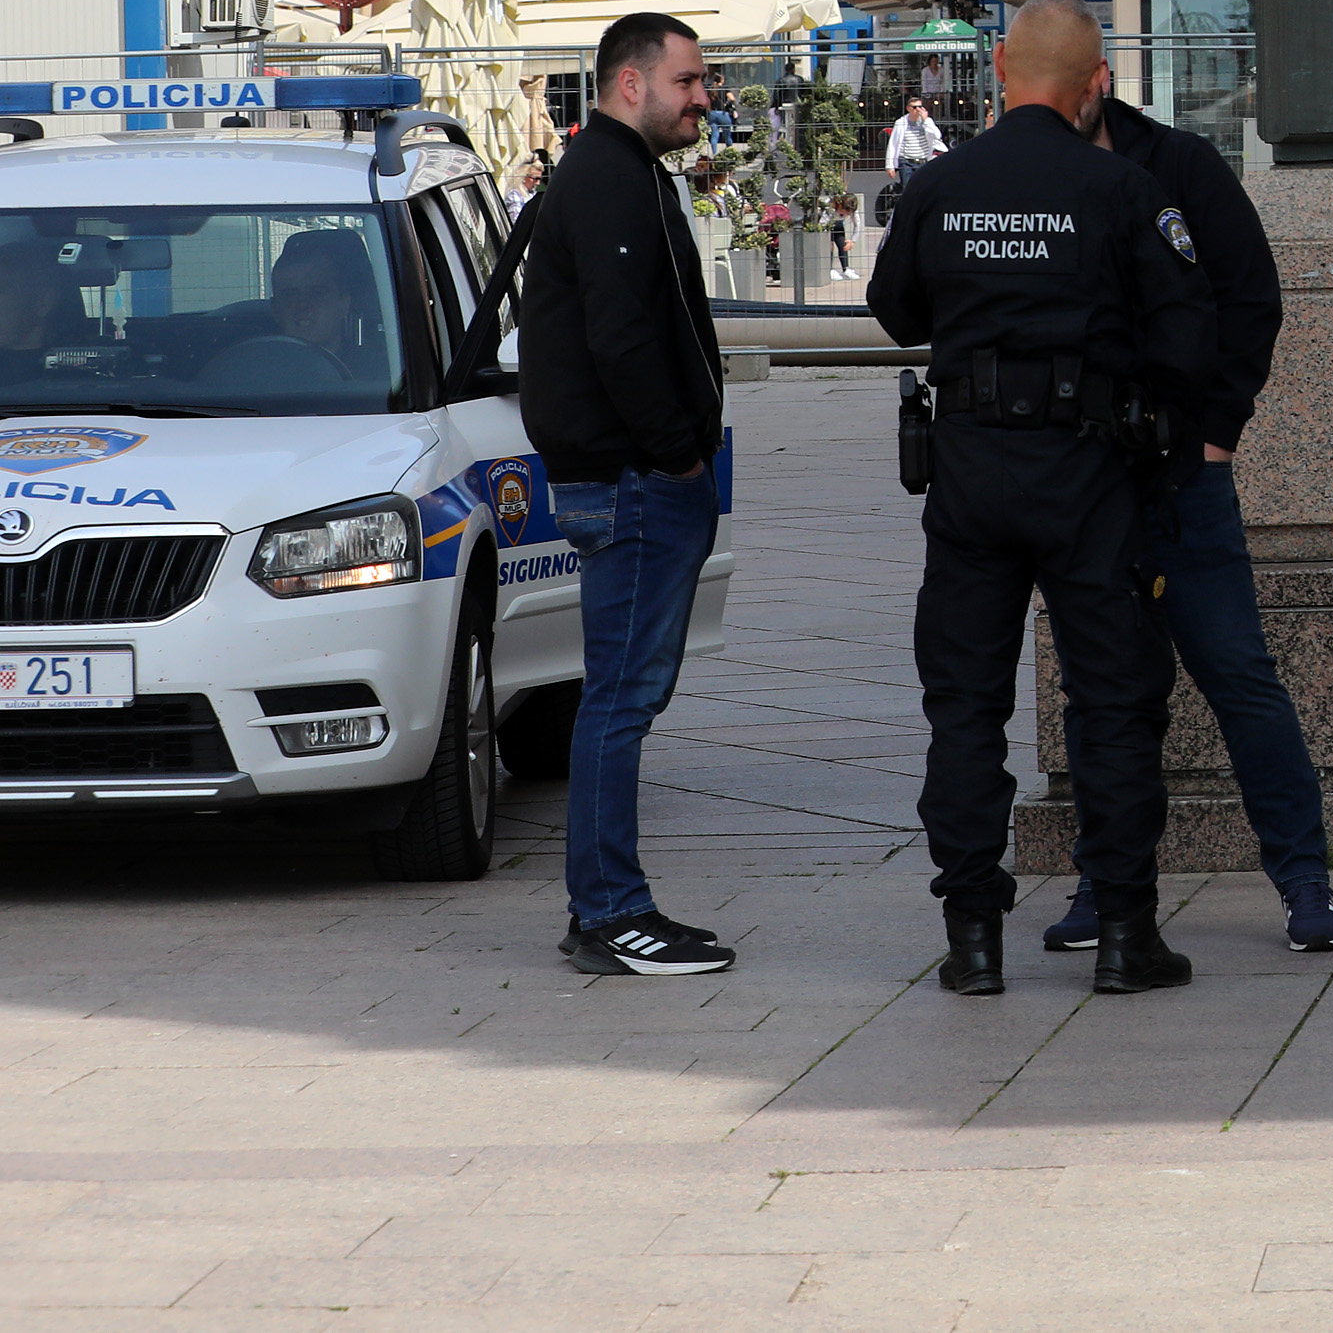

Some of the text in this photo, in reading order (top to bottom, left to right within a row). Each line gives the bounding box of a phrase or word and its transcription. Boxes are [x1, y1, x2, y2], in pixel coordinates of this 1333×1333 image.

[62, 83, 265, 110] POLICIJA
[942, 212, 1076, 233] INTERVENTNA
[963, 239, 1050, 260] POLICIJA
[0, 428, 135, 442] OLICIJA
[490, 462, 529, 481] POLICIJA
[0, 481, 177, 511] ICIJA
[503, 486, 520, 502] RH
[504, 504, 523, 512] MUP
[498, 551, 581, 587] SIGURNO
[26, 656, 92, 696] 251
